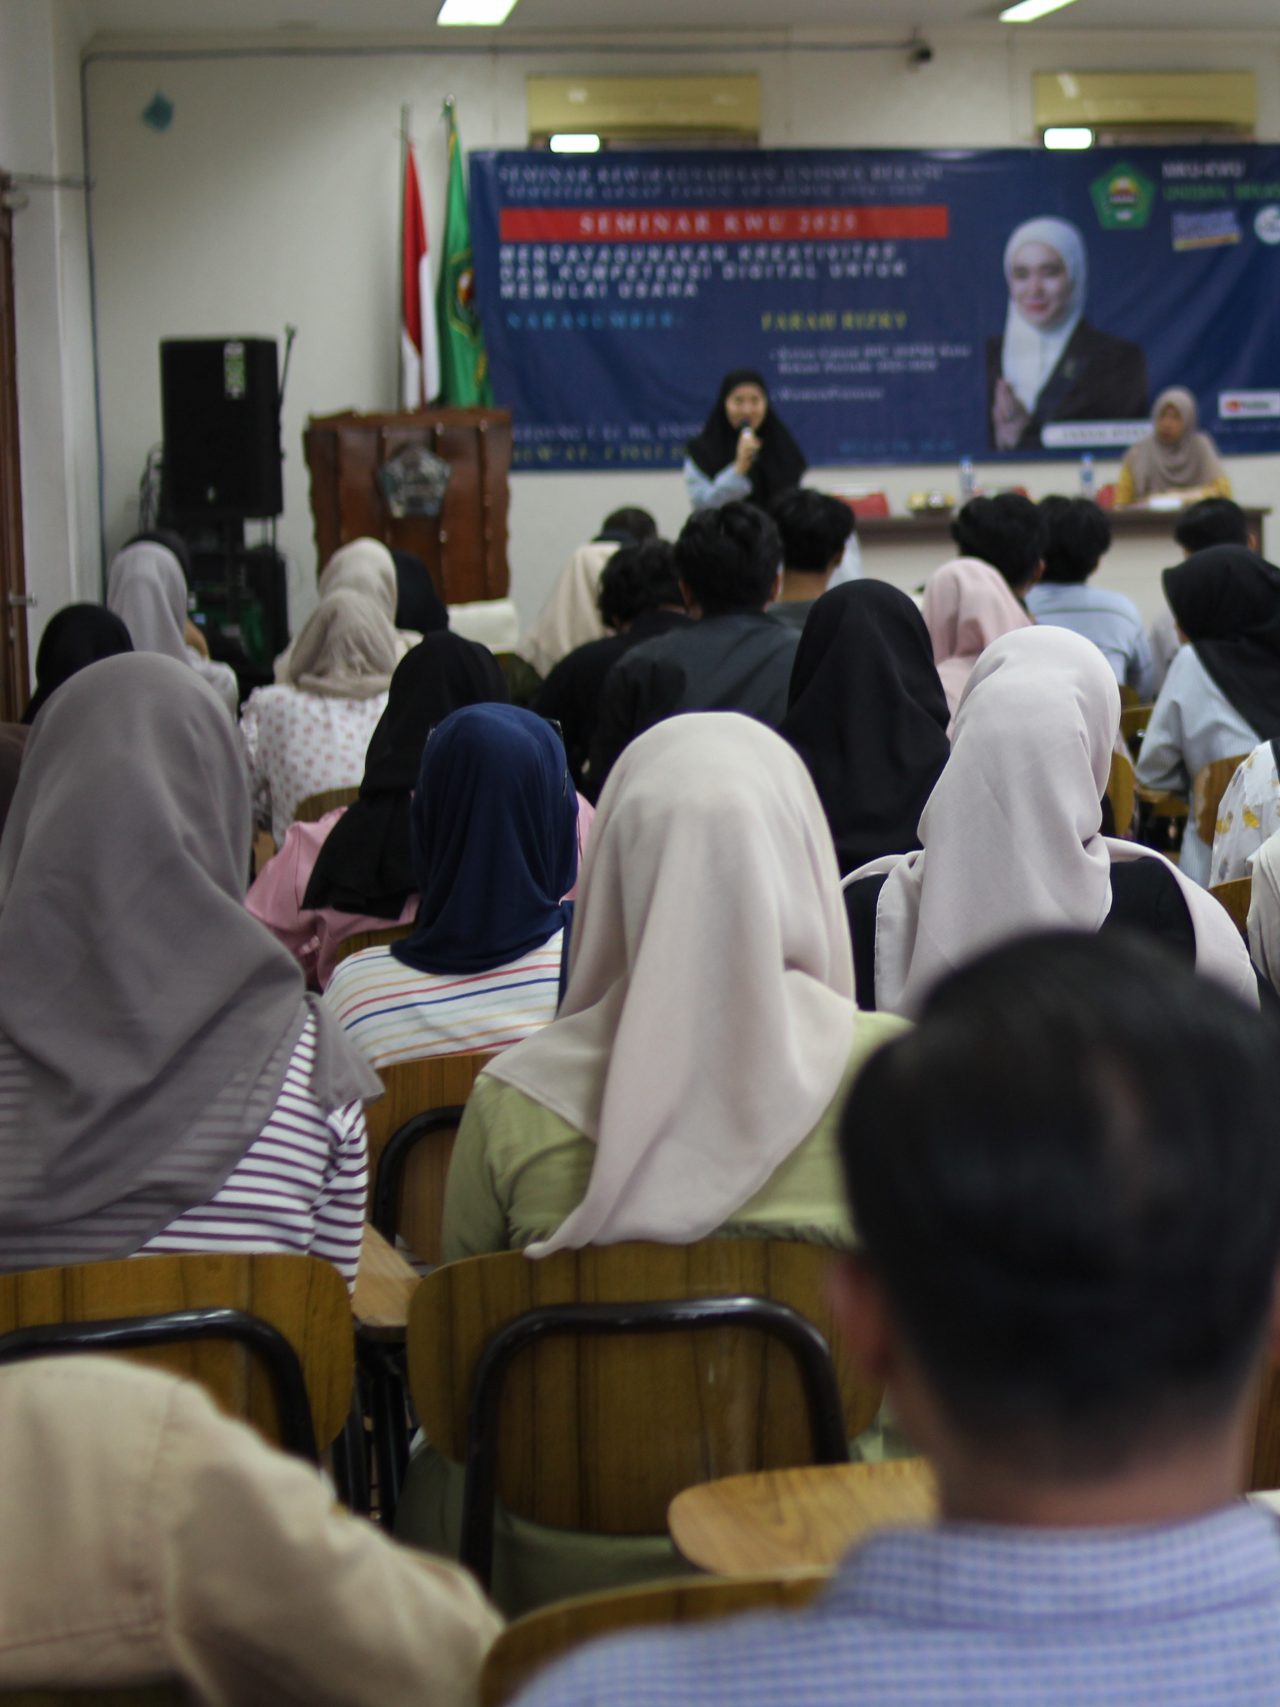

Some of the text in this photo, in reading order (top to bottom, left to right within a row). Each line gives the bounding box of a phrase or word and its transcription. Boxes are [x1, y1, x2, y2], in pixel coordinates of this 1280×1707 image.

[579, 212, 858, 235] SEMINAR KWU 2025
[500, 242, 898, 263] MENDAYAGUNAKAN KREATIVITAS
[500, 260, 908, 282] DAN KOMPETENSI DIGITAL UNTUK
[500, 281, 698, 300] MEMULAI USAHA
[760, 310, 908, 331] FARAH RIZKY
